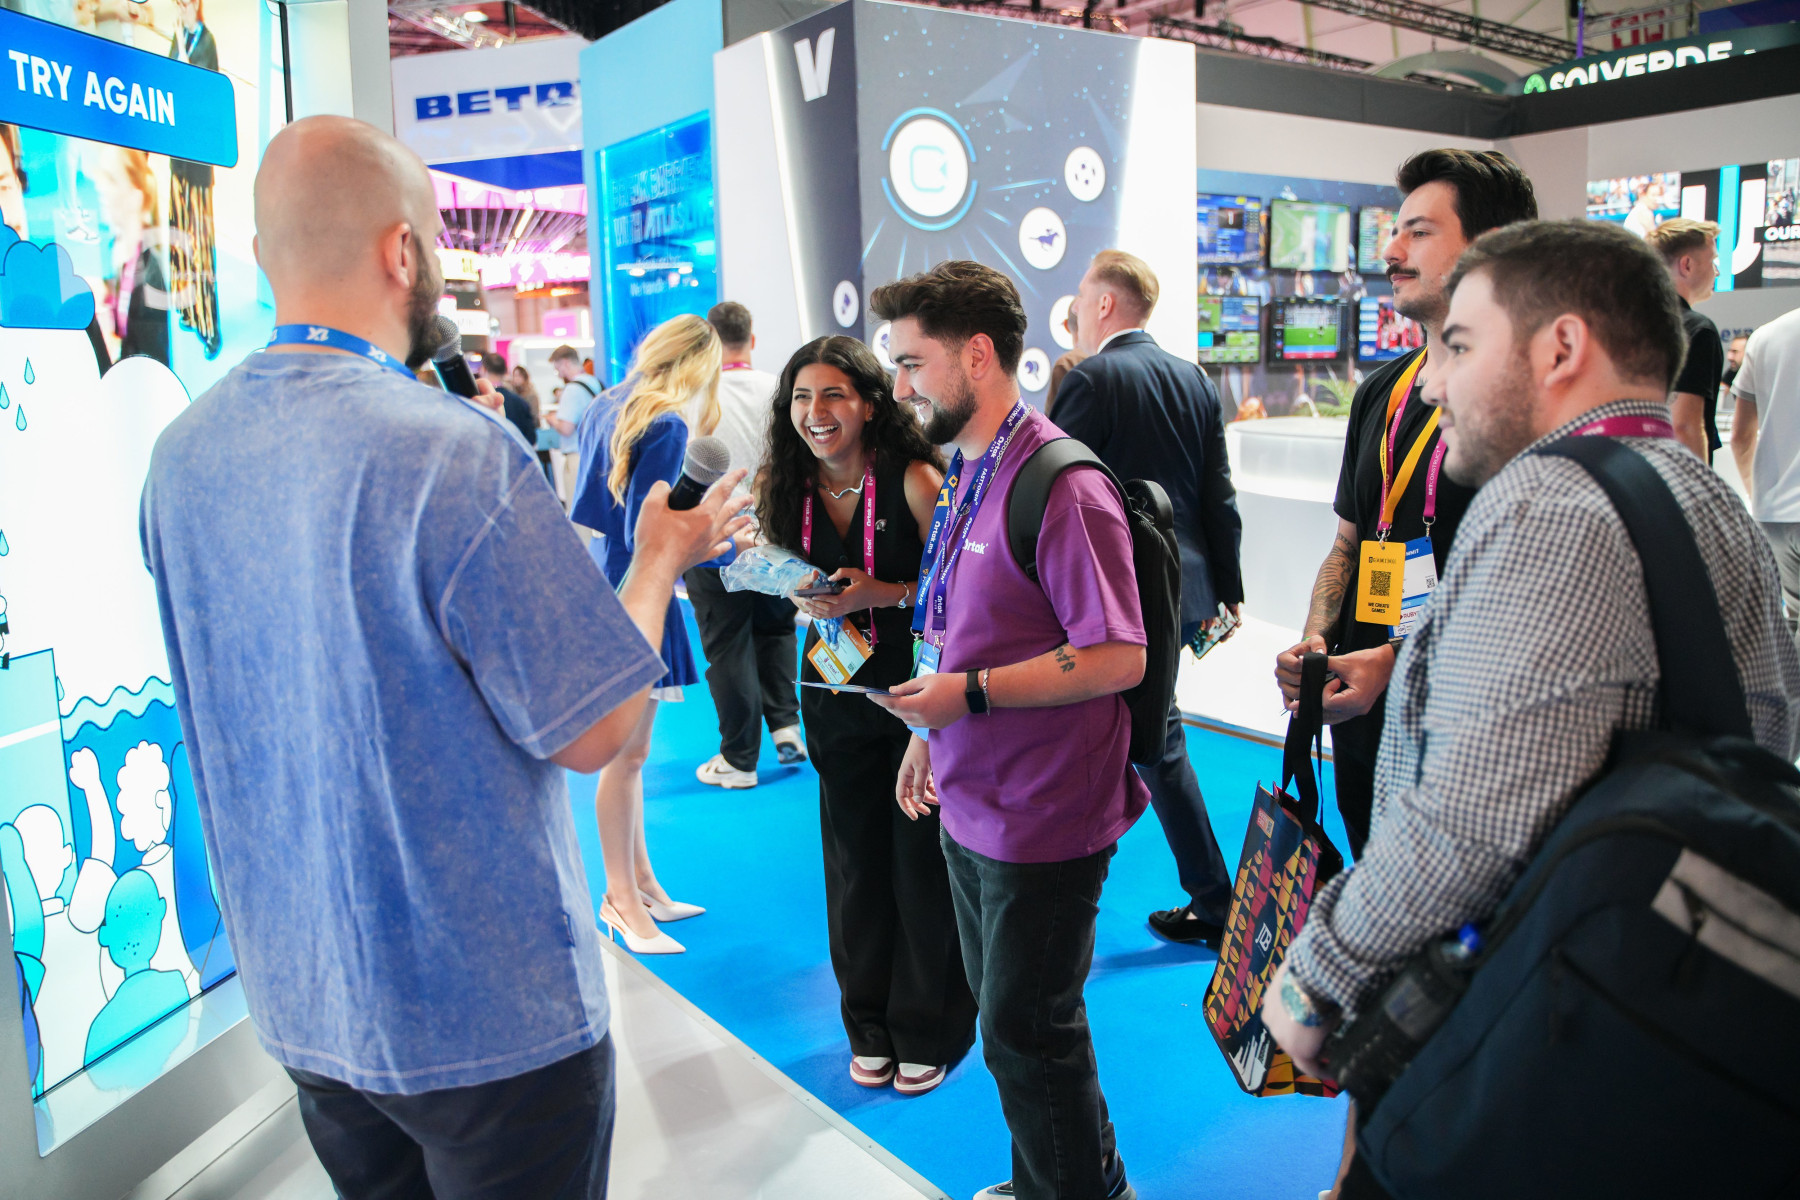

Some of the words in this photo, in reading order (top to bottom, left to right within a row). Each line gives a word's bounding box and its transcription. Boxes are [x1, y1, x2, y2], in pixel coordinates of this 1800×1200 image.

[8, 49, 73, 102] TRY
[83, 71, 176, 127] AGAIN
[973, 467, 988, 504] FASTTOKEN
[1428, 449, 1441, 496] BETCONSTRUCT
[926, 520, 941, 554] Ortak.me
